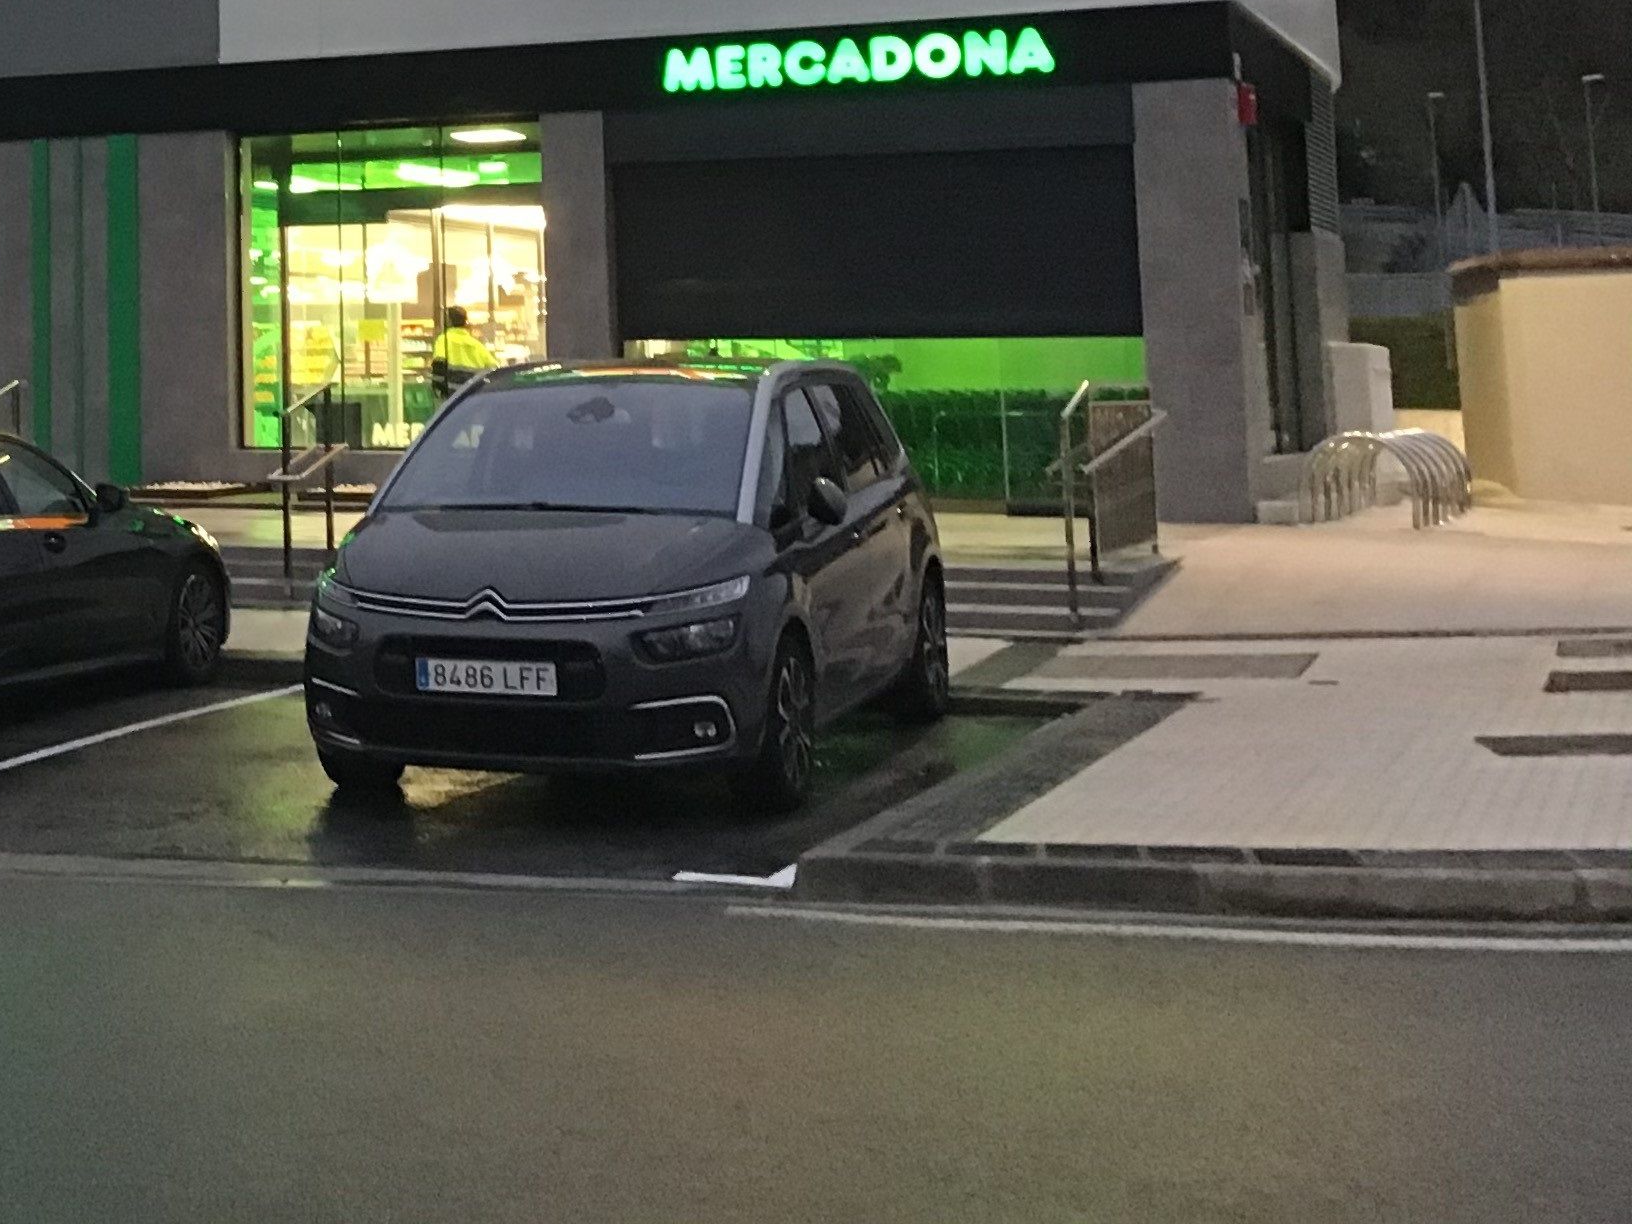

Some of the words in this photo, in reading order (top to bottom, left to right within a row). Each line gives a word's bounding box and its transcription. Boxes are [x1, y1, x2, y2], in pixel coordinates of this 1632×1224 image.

[663, 26, 1056, 93] MERCADONA
[433, 663, 495, 689] 8486
[503, 666, 550, 691] LFF
